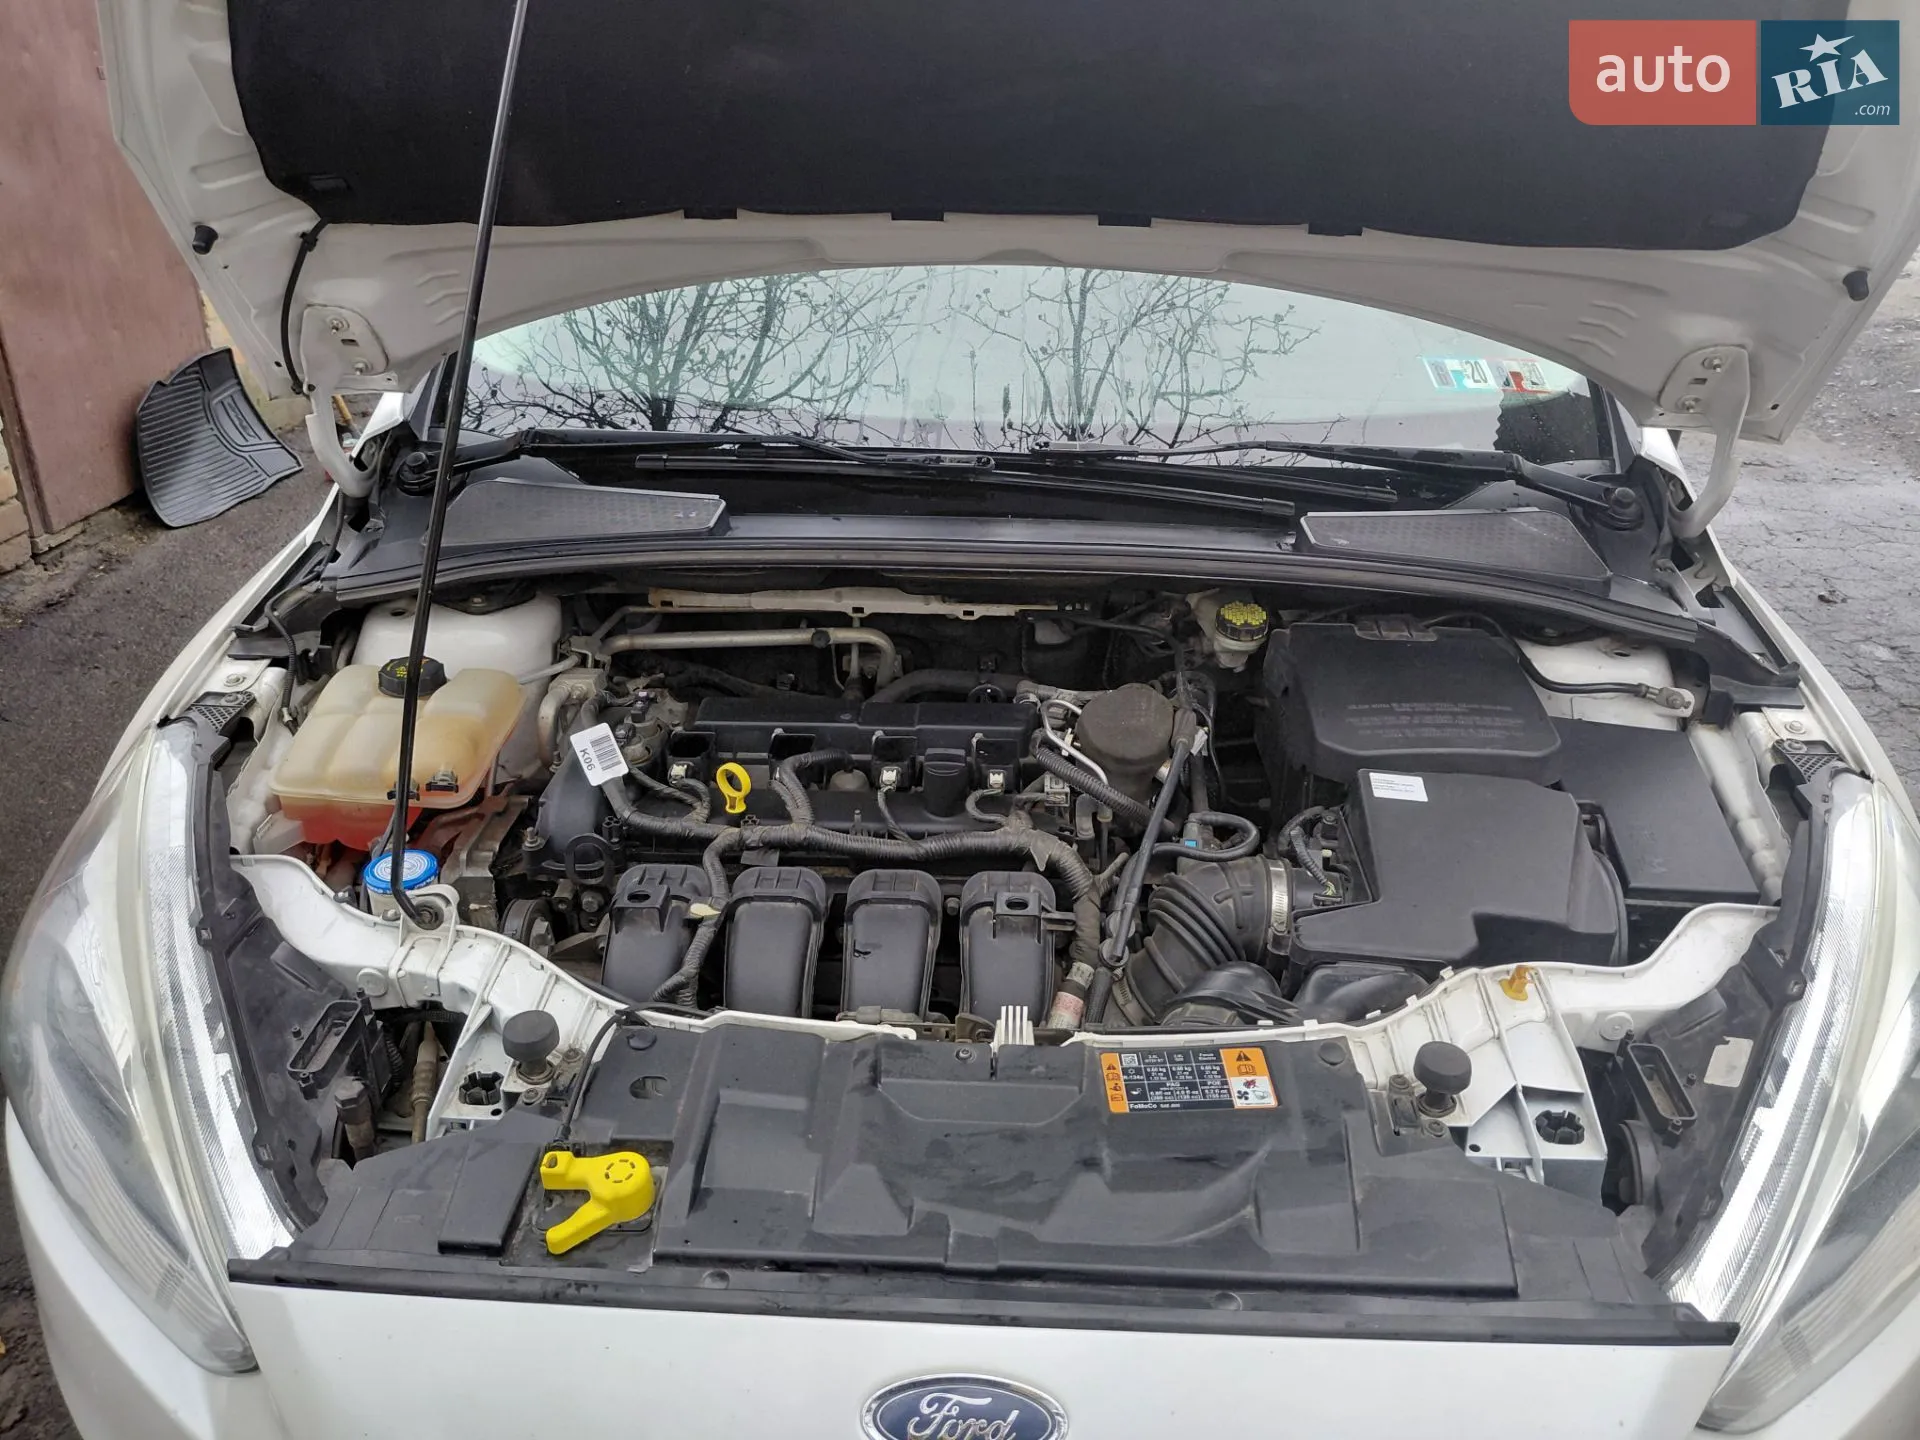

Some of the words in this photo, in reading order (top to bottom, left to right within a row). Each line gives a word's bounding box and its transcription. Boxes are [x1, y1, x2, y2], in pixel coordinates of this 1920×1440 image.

[1465, 360, 1488, 384] 20
[580, 748, 596, 771] K06
[907, 1392, 1019, 1440] Ford
